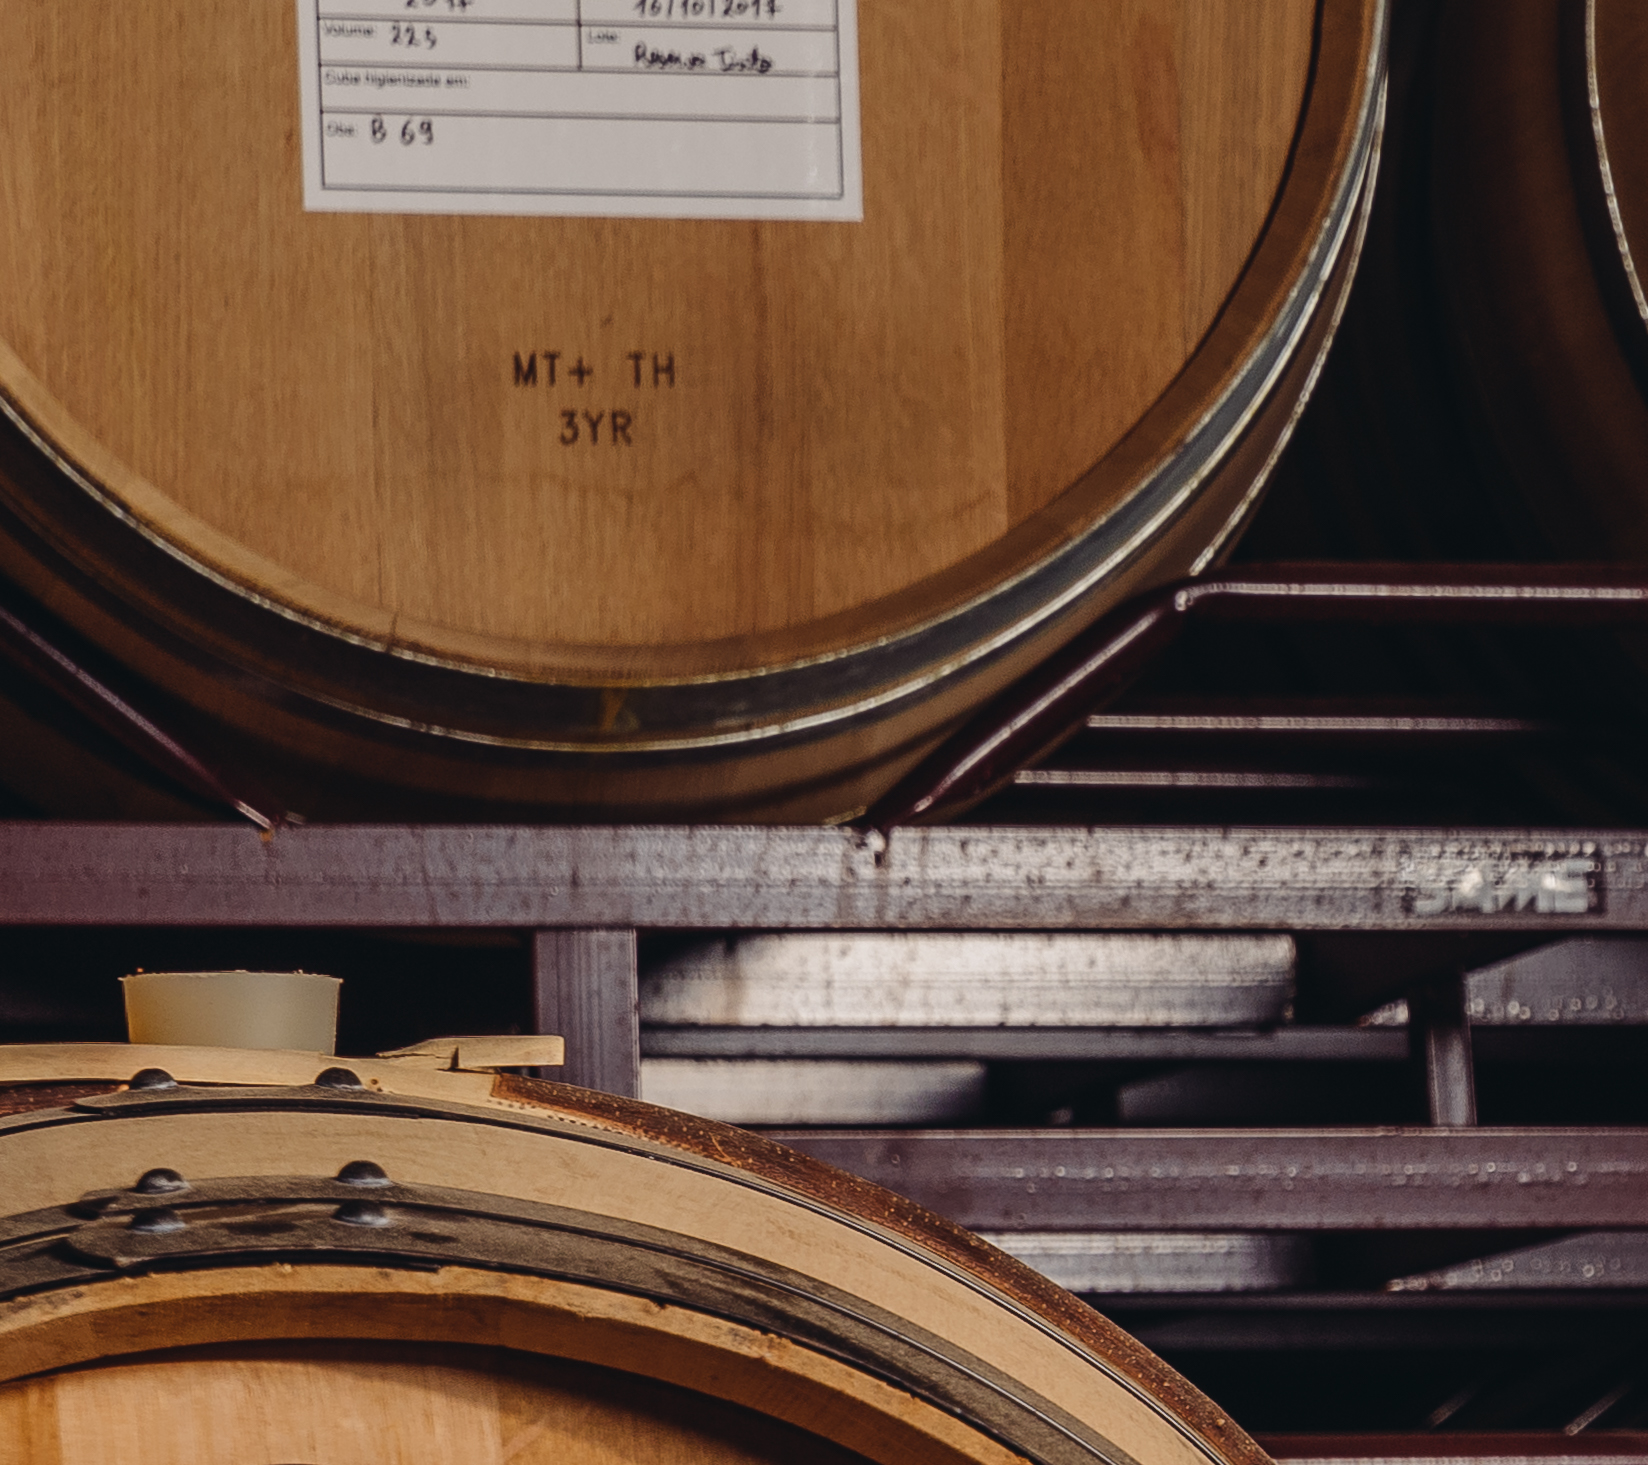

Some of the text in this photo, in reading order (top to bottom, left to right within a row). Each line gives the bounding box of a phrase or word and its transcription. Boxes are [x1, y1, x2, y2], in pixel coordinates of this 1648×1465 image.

[513, 351, 675, 388] MT+ TH
[560, 409, 632, 446] 3YR
